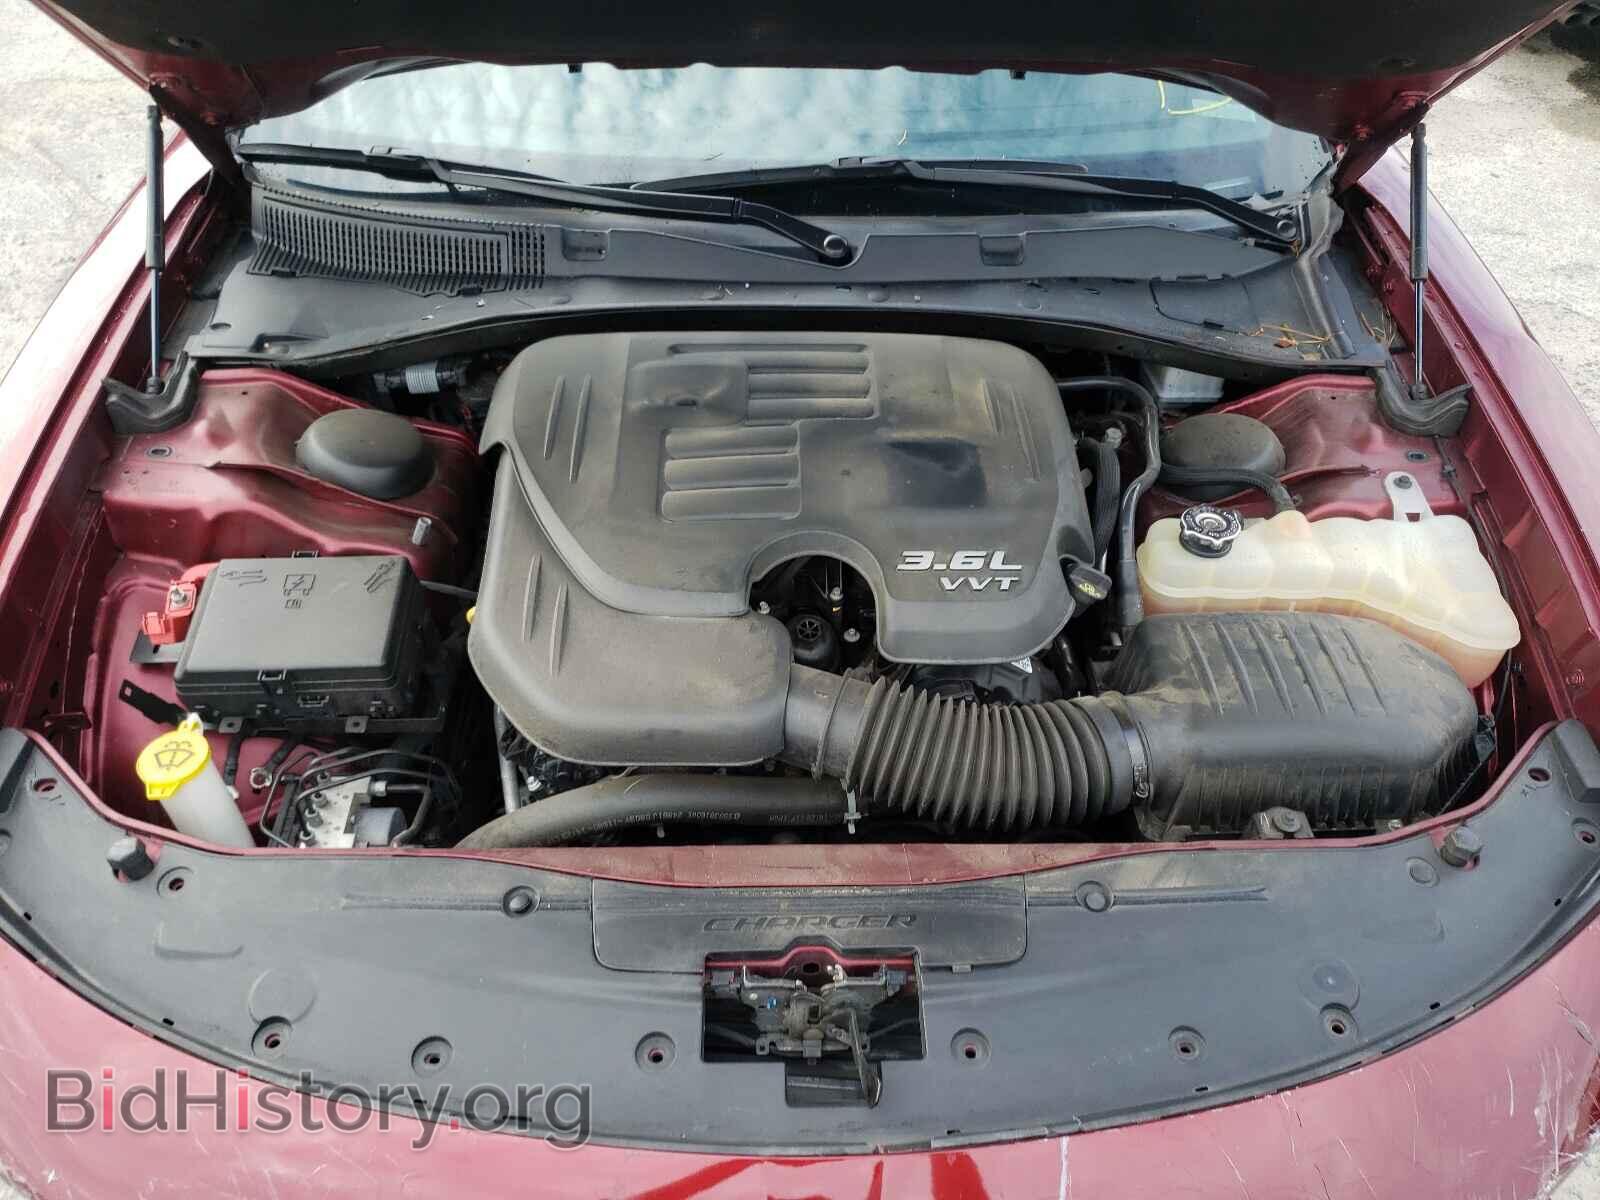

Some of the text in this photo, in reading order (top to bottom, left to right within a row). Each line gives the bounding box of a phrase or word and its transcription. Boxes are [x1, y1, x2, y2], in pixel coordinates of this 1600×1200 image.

[896, 550, 1023, 571] 3.6L
[939, 576, 1020, 592] VVT
[703, 913, 917, 932] CHARGER
